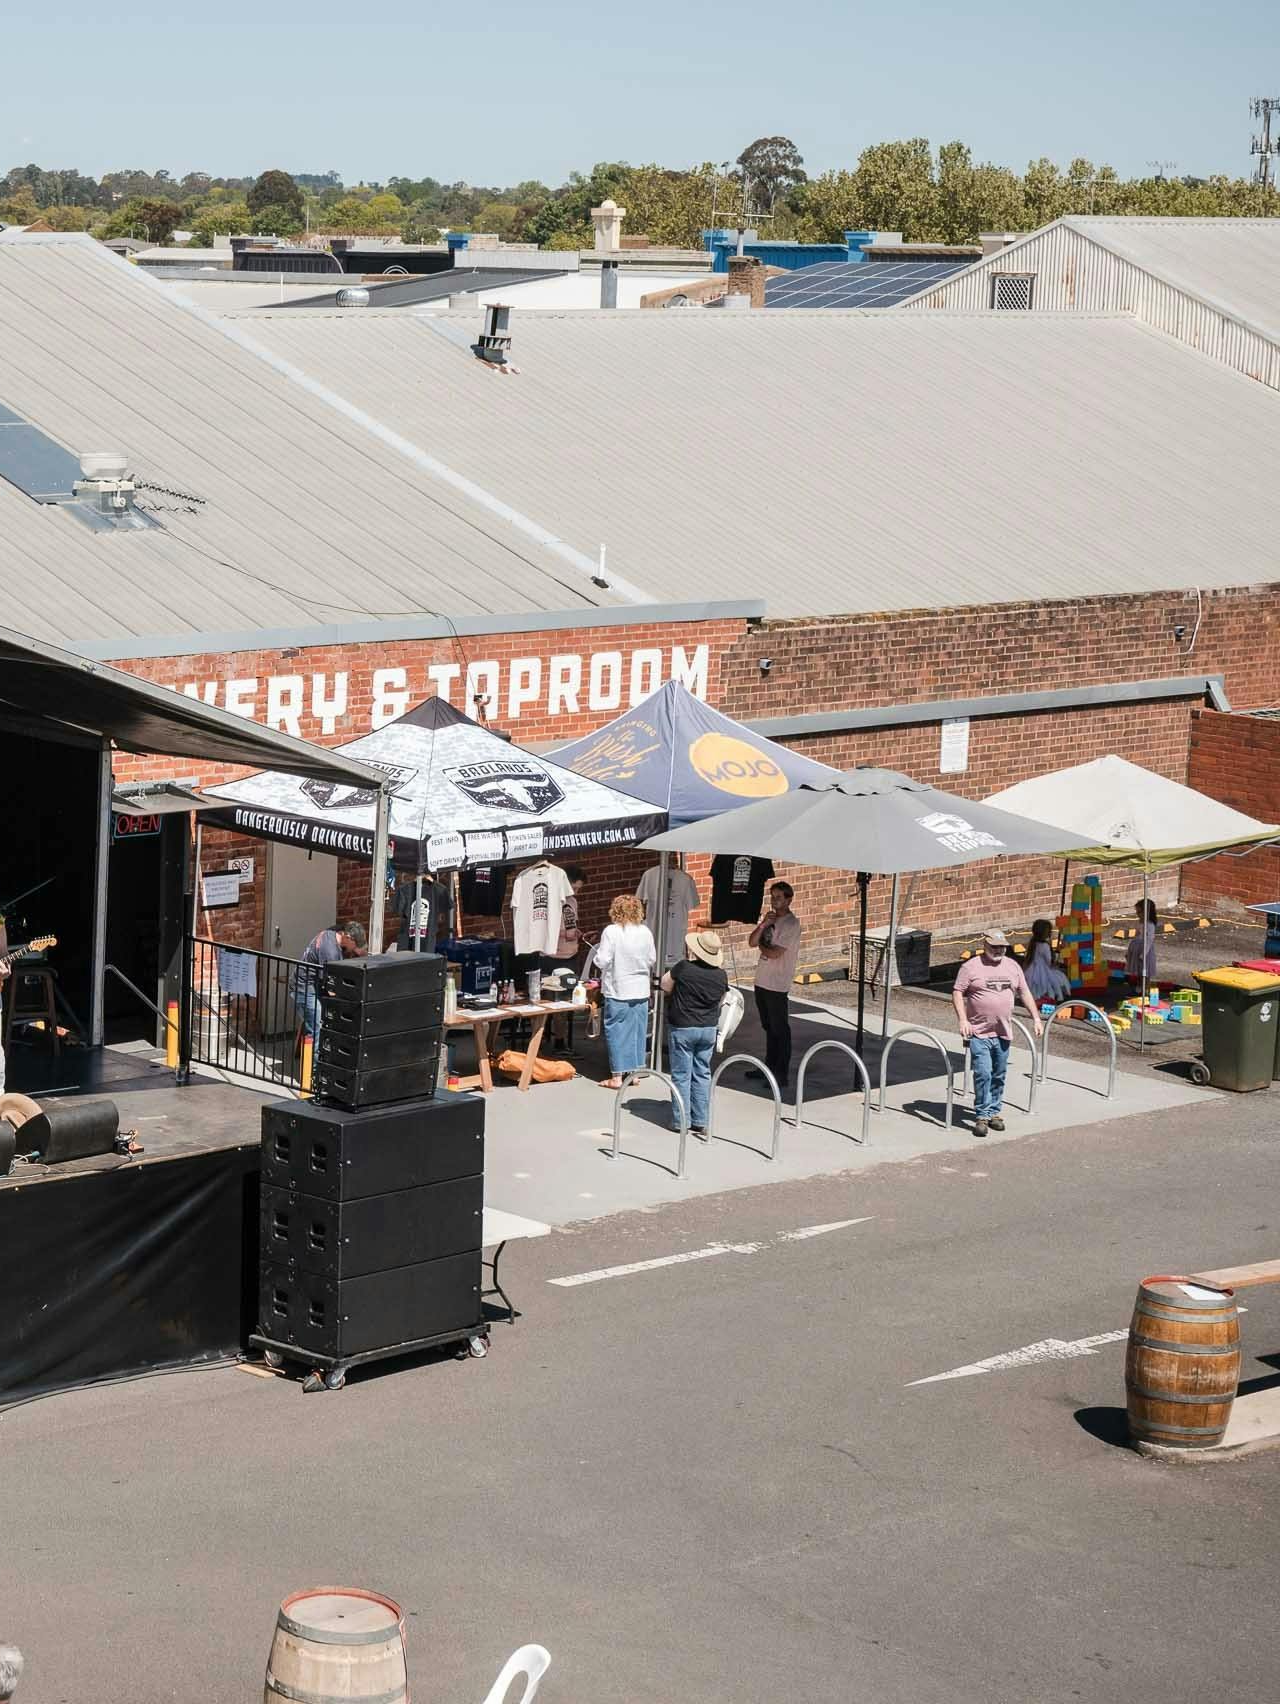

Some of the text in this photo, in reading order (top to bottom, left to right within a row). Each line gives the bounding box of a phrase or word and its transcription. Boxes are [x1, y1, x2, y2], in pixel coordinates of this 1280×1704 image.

[372, 667, 410, 732] &
[427, 644, 710, 721] TAPROOM
[461, 763, 532, 778] BADLANDS
[699, 759, 779, 783] MOJO
[116, 813, 161, 835] OPEN
[235, 808, 373, 855] DANGEROUSLY DRINKABLE
[467, 833, 480, 841] FREE
